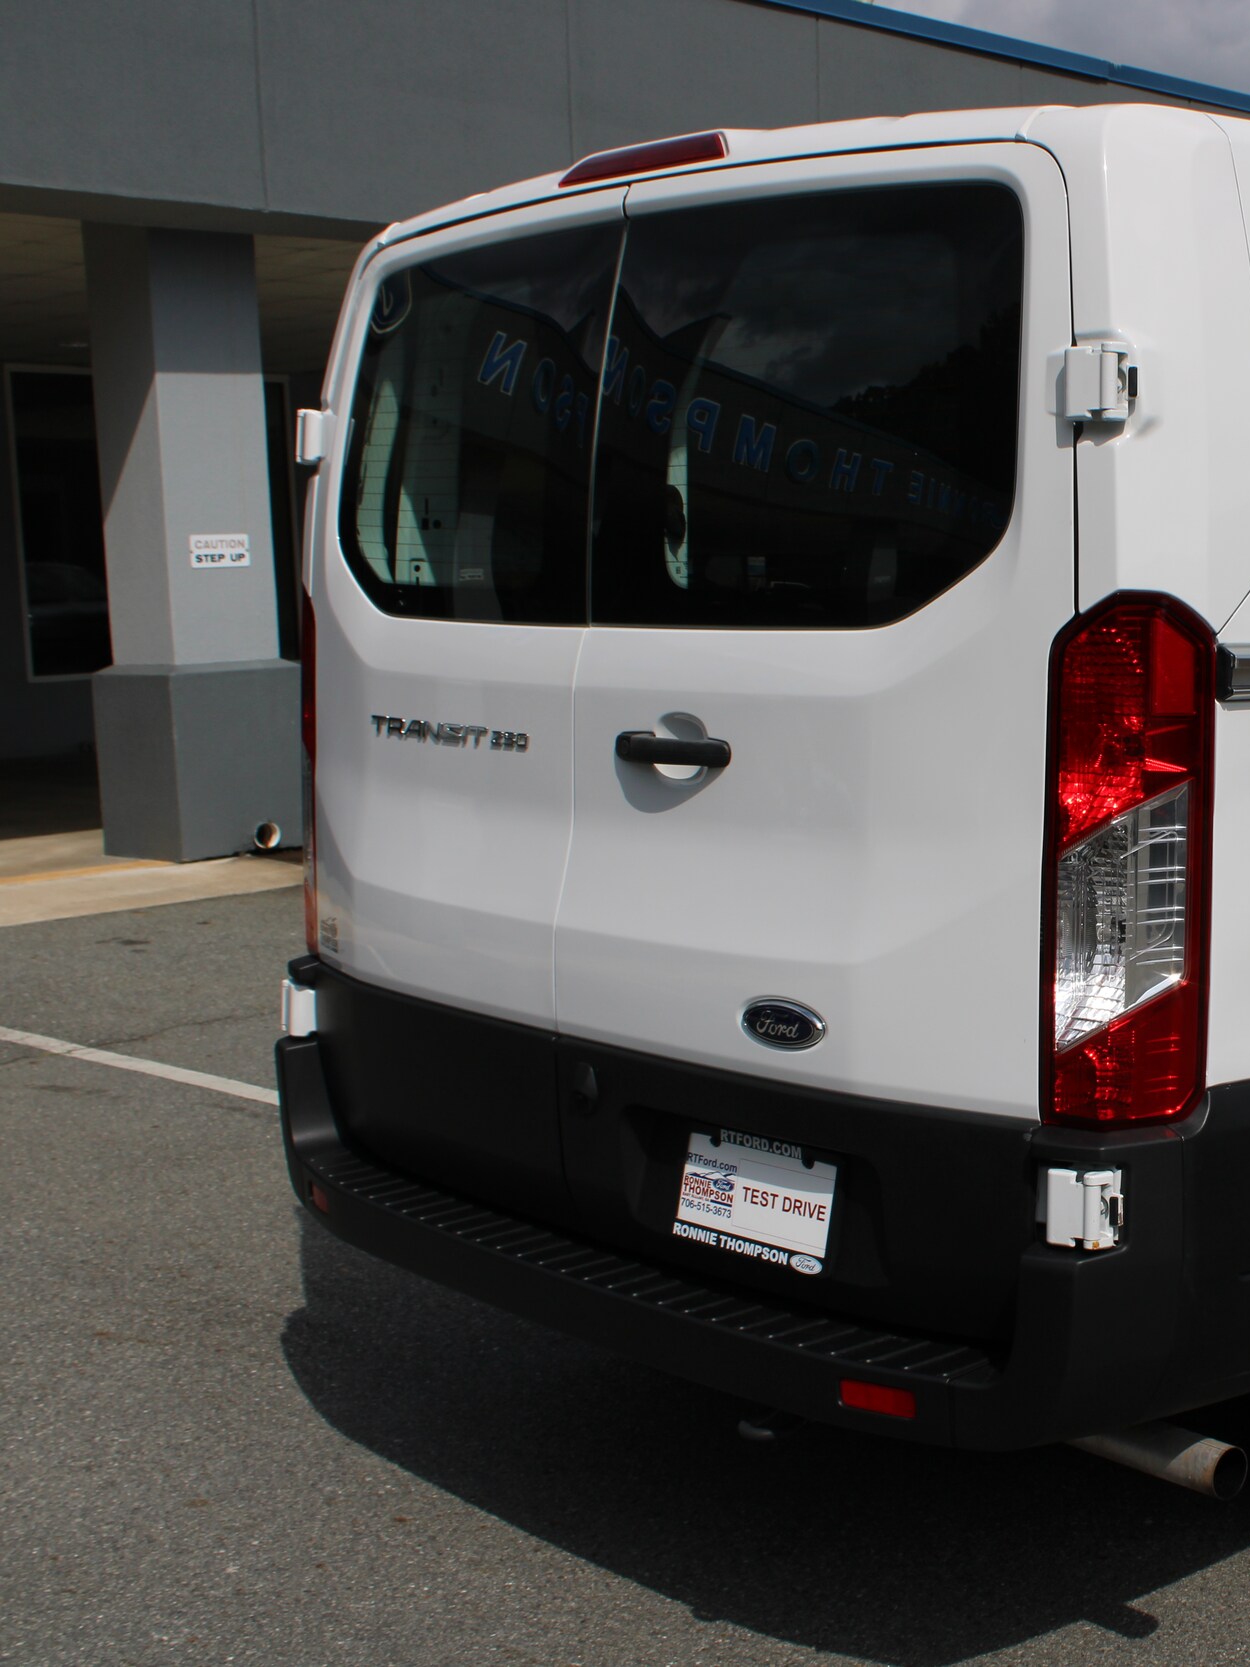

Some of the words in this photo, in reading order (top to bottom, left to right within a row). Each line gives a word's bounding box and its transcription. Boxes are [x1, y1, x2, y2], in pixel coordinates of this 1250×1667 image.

[194, 539, 246, 549] CAUTION
[195, 553, 226, 563] STEP
[230, 552, 246, 562] UP
[371, 714, 489, 747] TRANSIT
[756, 1010, 800, 1039] Ford
[719, 1128, 802, 1159] RTFORD.COM
[686, 1152, 738, 1173] RTFord.com
[683, 1182, 734, 1204] THOMPSON
[684, 1175, 712, 1189] RONNIE
[680, 1196, 732, 1219] 706-515-3673
[742, 1186, 779, 1210] TEST
[782, 1196, 827, 1222] DRIVE
[672, 1221, 718, 1246] RONNIE
[719, 1234, 789, 1266] THOMPSON
